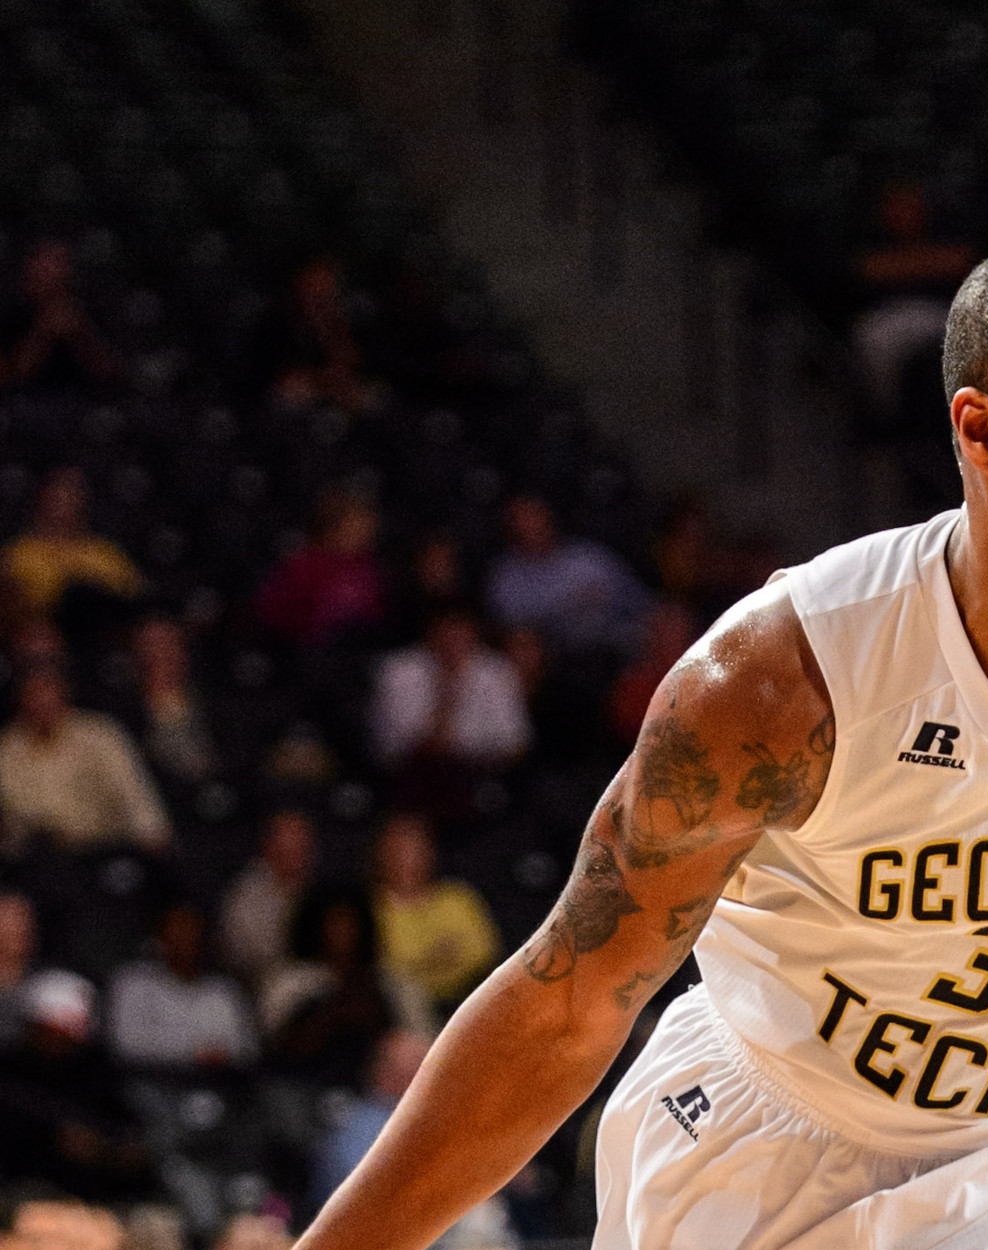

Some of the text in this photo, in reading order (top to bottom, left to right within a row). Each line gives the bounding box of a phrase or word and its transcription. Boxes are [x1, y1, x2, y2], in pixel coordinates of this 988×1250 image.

[911, 721, 961, 756] R
[897, 751, 966, 770] RUSSELL
[661, 1095, 699, 1142] RUSSELL
